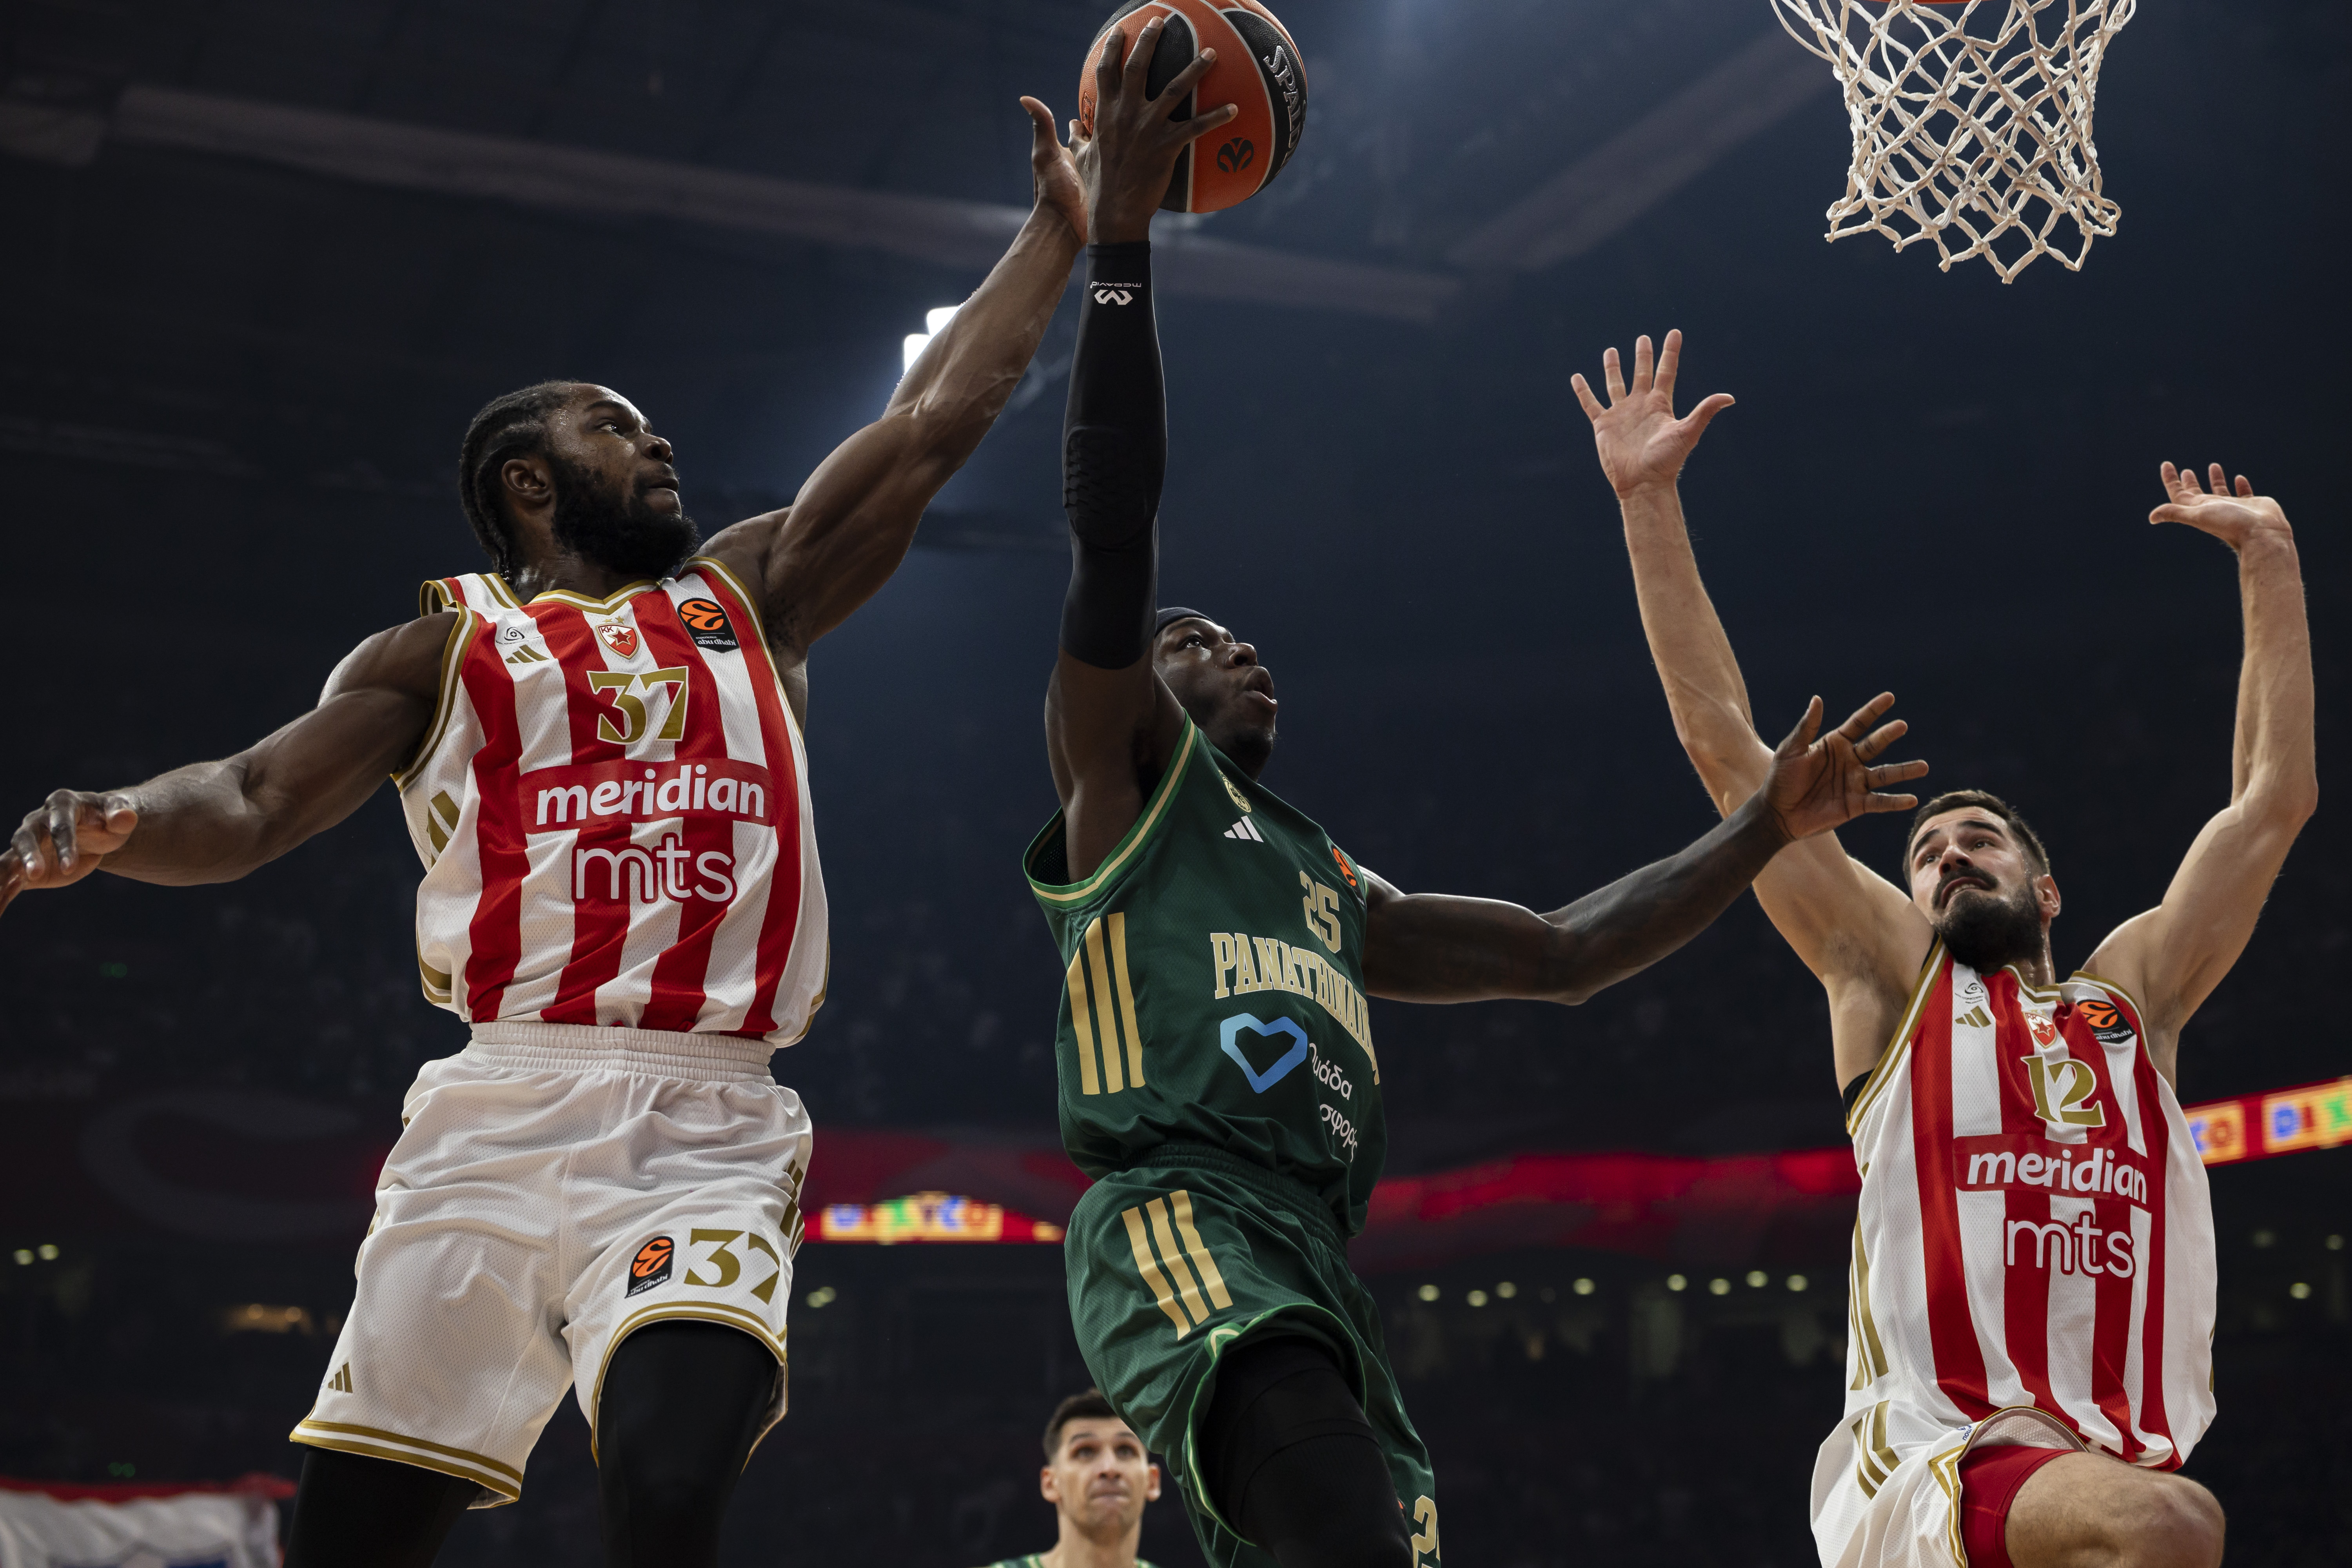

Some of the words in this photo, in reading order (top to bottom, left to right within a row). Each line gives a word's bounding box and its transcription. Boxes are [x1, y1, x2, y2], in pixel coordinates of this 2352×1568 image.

[586, 666, 689, 745] 37
[536, 764, 764, 826] meridian
[575, 837, 733, 902] mts
[1299, 870, 1341, 954] 25
[2020, 1055, 2105, 1127] 12
[1967, 1147, 2147, 1205] meridian
[683, 1228, 780, 1306] 37
[2007, 1214, 2134, 1278] mts
[1411, 1495, 1441, 1568] 2
